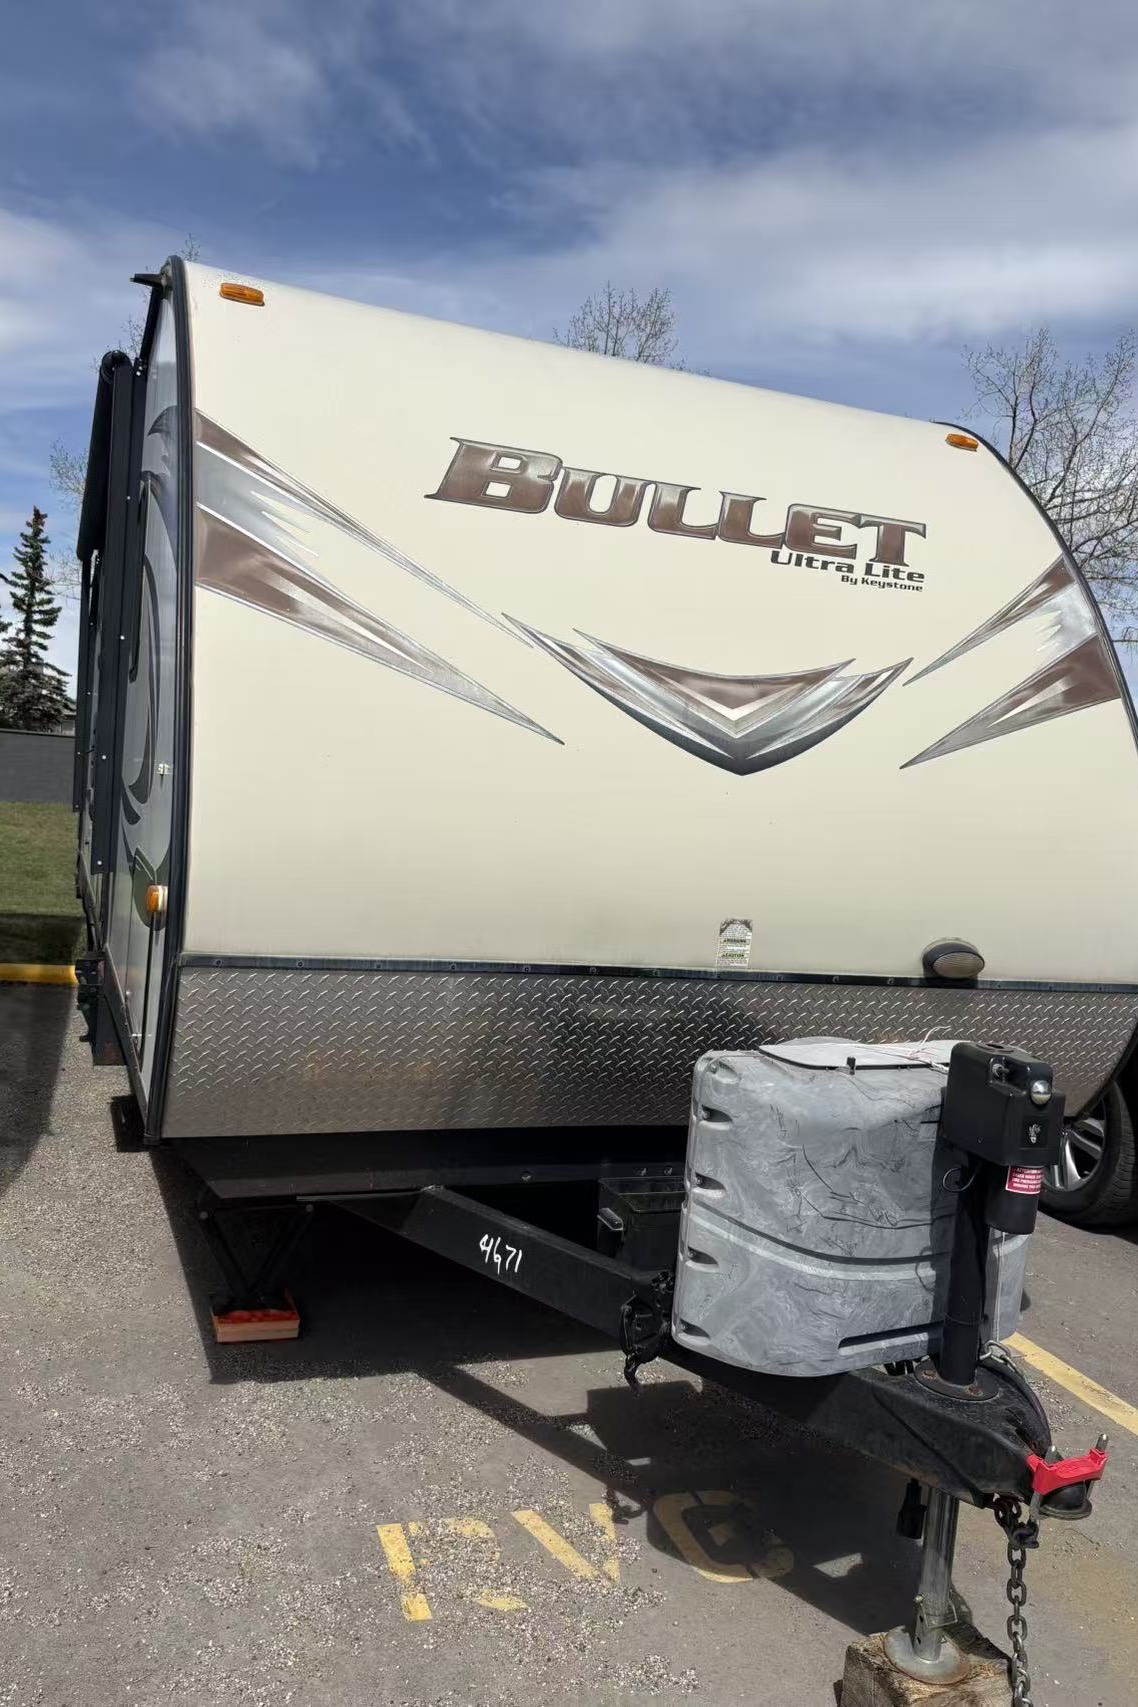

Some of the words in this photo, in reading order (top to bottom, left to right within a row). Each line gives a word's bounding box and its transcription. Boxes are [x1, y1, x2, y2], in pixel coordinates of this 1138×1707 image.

[424, 437, 927, 567] BULLET
[770, 550, 855, 574] Ultra
[864, 563, 925, 583] Lite
[841, 575, 858, 586] By
[861, 577, 923, 592] Keystone
[479, 1233, 523, 1276] 4671
